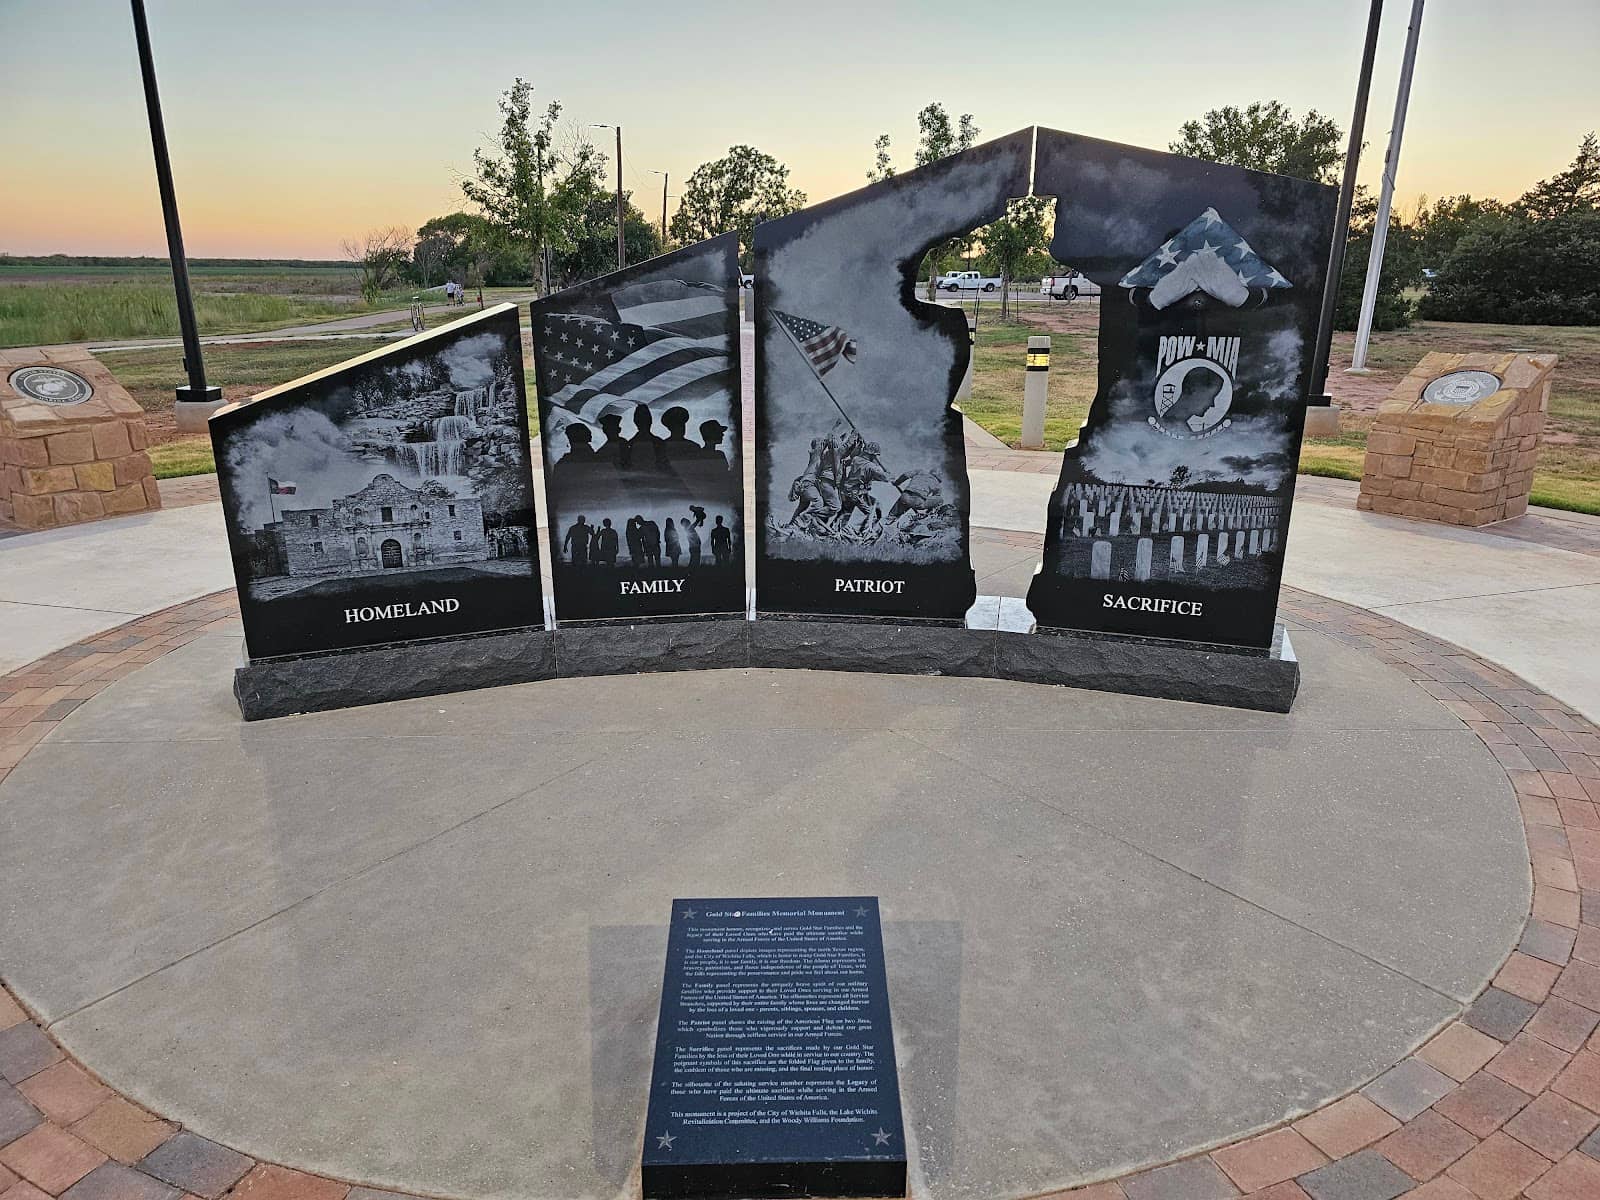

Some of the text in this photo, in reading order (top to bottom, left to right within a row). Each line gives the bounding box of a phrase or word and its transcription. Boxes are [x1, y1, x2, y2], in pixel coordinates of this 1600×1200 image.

[1155, 335, 1241, 380] POW MIA
[620, 579, 686, 595] FAMILY
[834, 578, 906, 594] PATRIOT
[343, 598, 460, 623] HOMELAND
[1102, 593, 1203, 616] SACRIFICE
